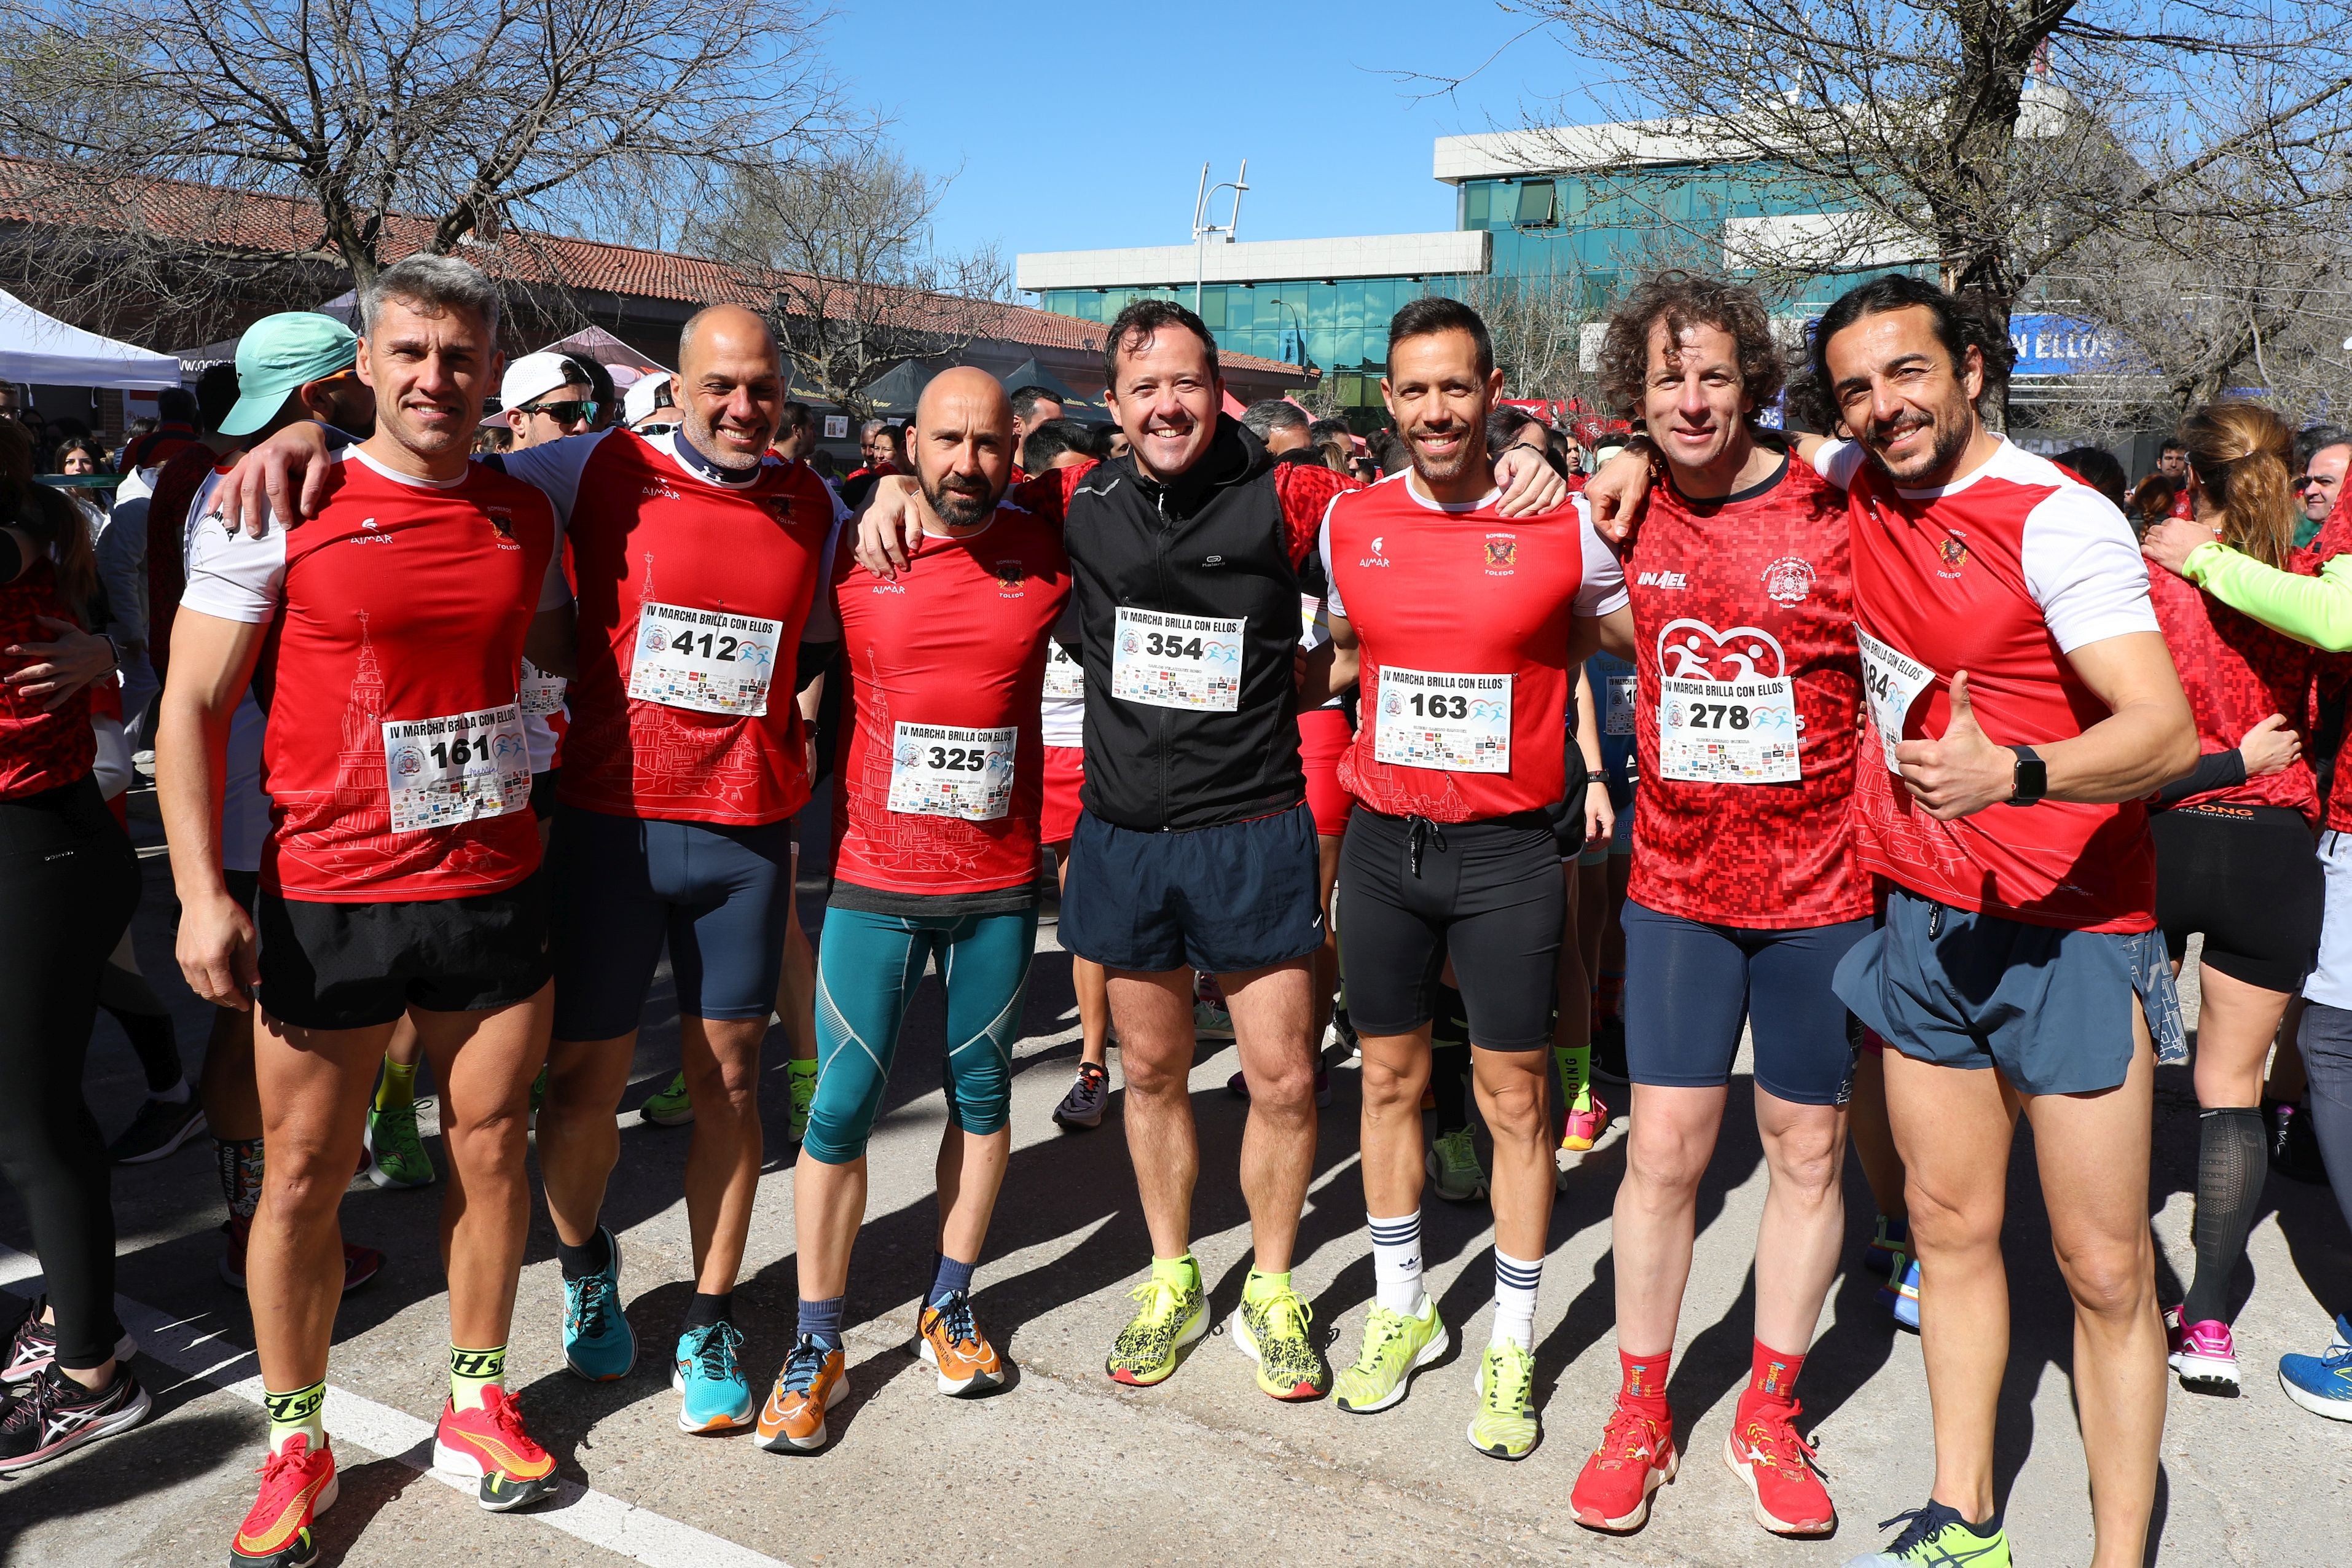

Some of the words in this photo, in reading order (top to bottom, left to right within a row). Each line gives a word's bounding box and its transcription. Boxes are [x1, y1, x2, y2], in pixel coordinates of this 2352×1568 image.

[2036, 333, 2114, 359] ELLOS
[643, 486, 681, 500] AIMAR
[350, 534, 393, 544] AIMAR
[1359, 558, 1390, 568] AIMAR
[1937, 570, 1961, 579] TOLEDO
[872, 585, 906, 594] AIMAR
[1637, 570, 1687, 589] INAEL
[647, 605, 657, 616] IV
[658, 608, 697, 623] MARCHA
[699, 614, 727, 627] BRILLA
[731, 618, 747, 630] CON
[749, 621, 774, 633] ELLOS
[1121, 611, 1130, 621] IV
[1130, 614, 1162, 625] MARCHA
[1166, 617, 1192, 629] BRILLA
[1194, 621, 1210, 631] CON
[1213, 622, 1237, 633] ELLOS
[672, 630, 738, 662] 412
[1147, 633, 1203, 660] 354
[1871, 643, 1887, 662] BRILLA
[1887, 653, 1899, 668] CON
[1897, 660, 1923, 680] ELLOS
[1384, 670, 1391, 681] IV
[1393, 673, 1424, 686] MARCHA
[1427, 676, 1455, 688] BRILLA
[1458, 678, 1475, 689] CON
[1478, 678, 1503, 689] ELLOS
[1666, 681, 1672, 692] IV
[1674, 682, 1703, 696] MARCHA
[1706, 684, 1733, 697] BRILLA
[1737, 685, 1755, 697] CON
[1758, 682, 1783, 696] ELLOS
[1410, 693, 1467, 719] 163
[1690, 703, 1749, 730] 278
[390, 727, 399, 739] IV
[403, 722, 445, 737] MARCHA
[479, 713, 495, 729] CON
[497, 708, 515, 724] ELLOS
[900, 726, 907, 735] IV
[911, 727, 945, 740] MARCHA
[949, 732, 975, 742] BRILLA
[978, 732, 992, 742] CON
[994, 731, 1012, 742] ELLOS
[430, 734, 490, 769] 161
[927, 747, 984, 772] 325
[2178, 808, 2255, 821] ERFORMANCE
[1565, 1058, 1579, 1100] GOING
[224, 1147, 235, 1200] ALEJANDRO
